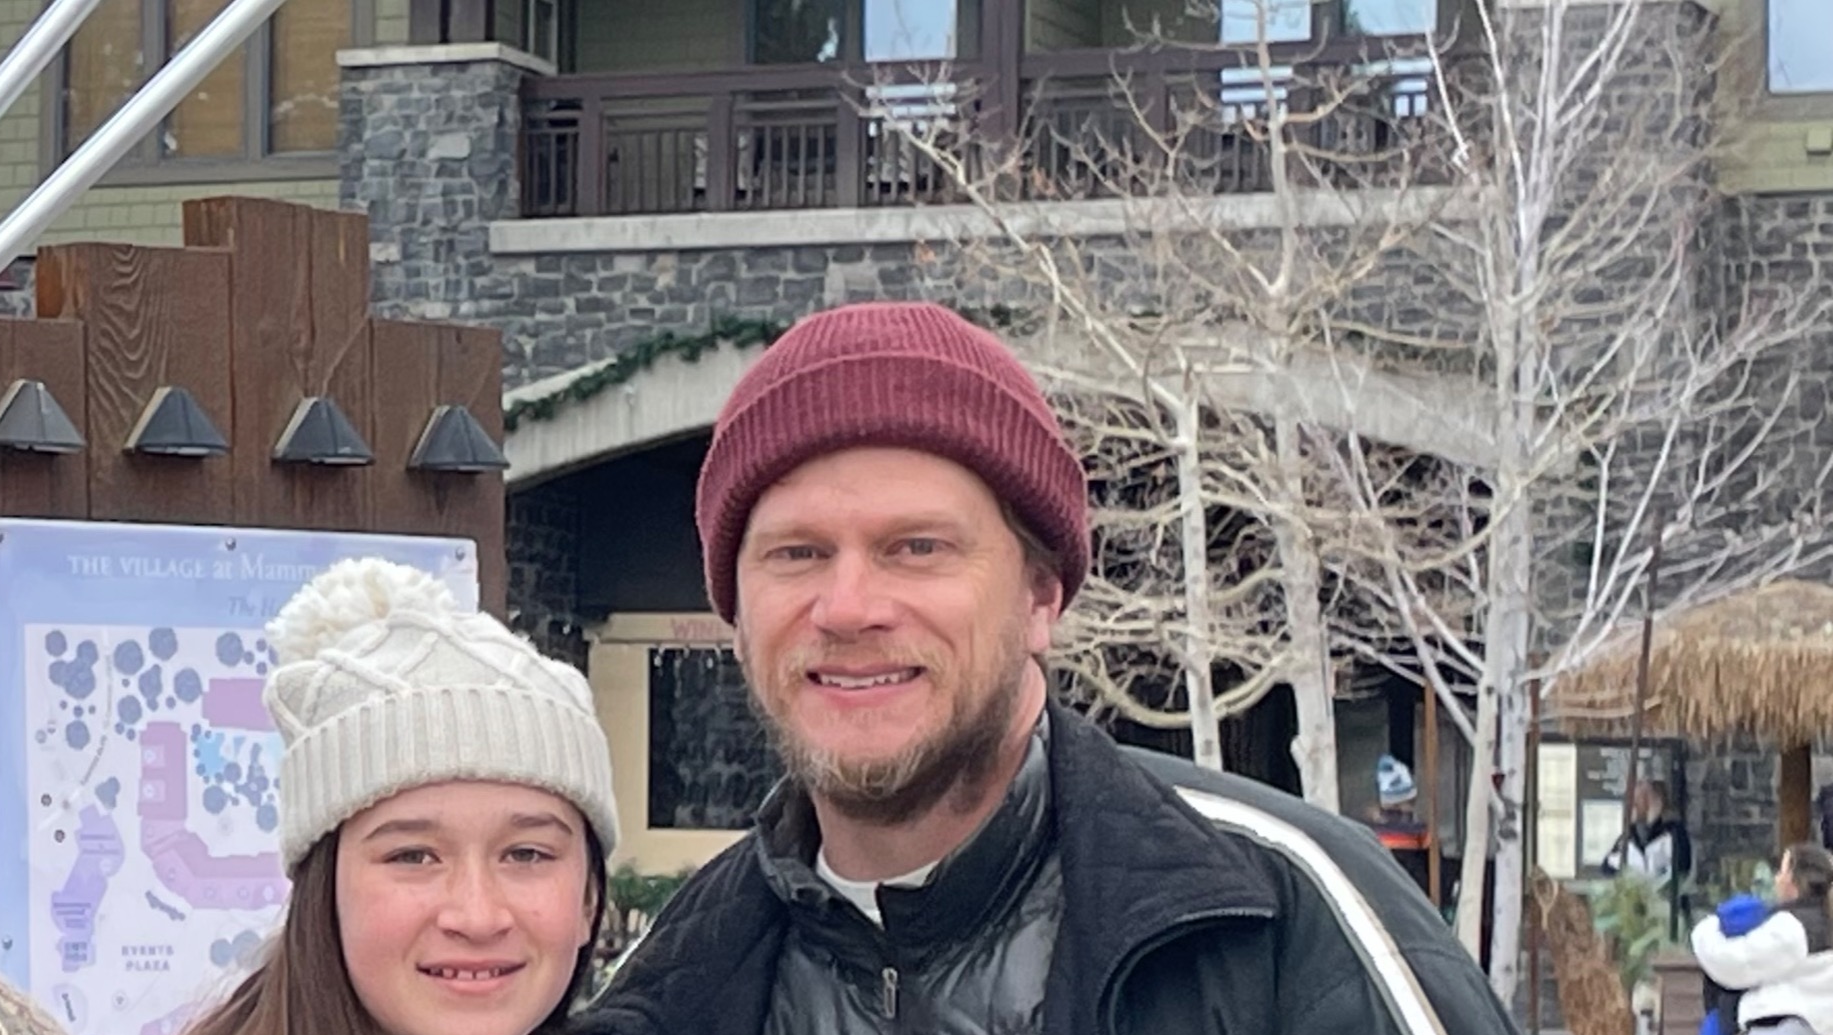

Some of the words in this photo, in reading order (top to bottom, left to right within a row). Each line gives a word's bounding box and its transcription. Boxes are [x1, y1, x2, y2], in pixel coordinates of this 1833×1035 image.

[67, 555, 112, 576] THE
[119, 556, 206, 580] VILLAGE
[212, 560, 233, 581] at
[239, 552, 317, 582] Mamm
[121, 945, 174, 957] EVENTS
[125, 960, 171, 972] PLAZA
